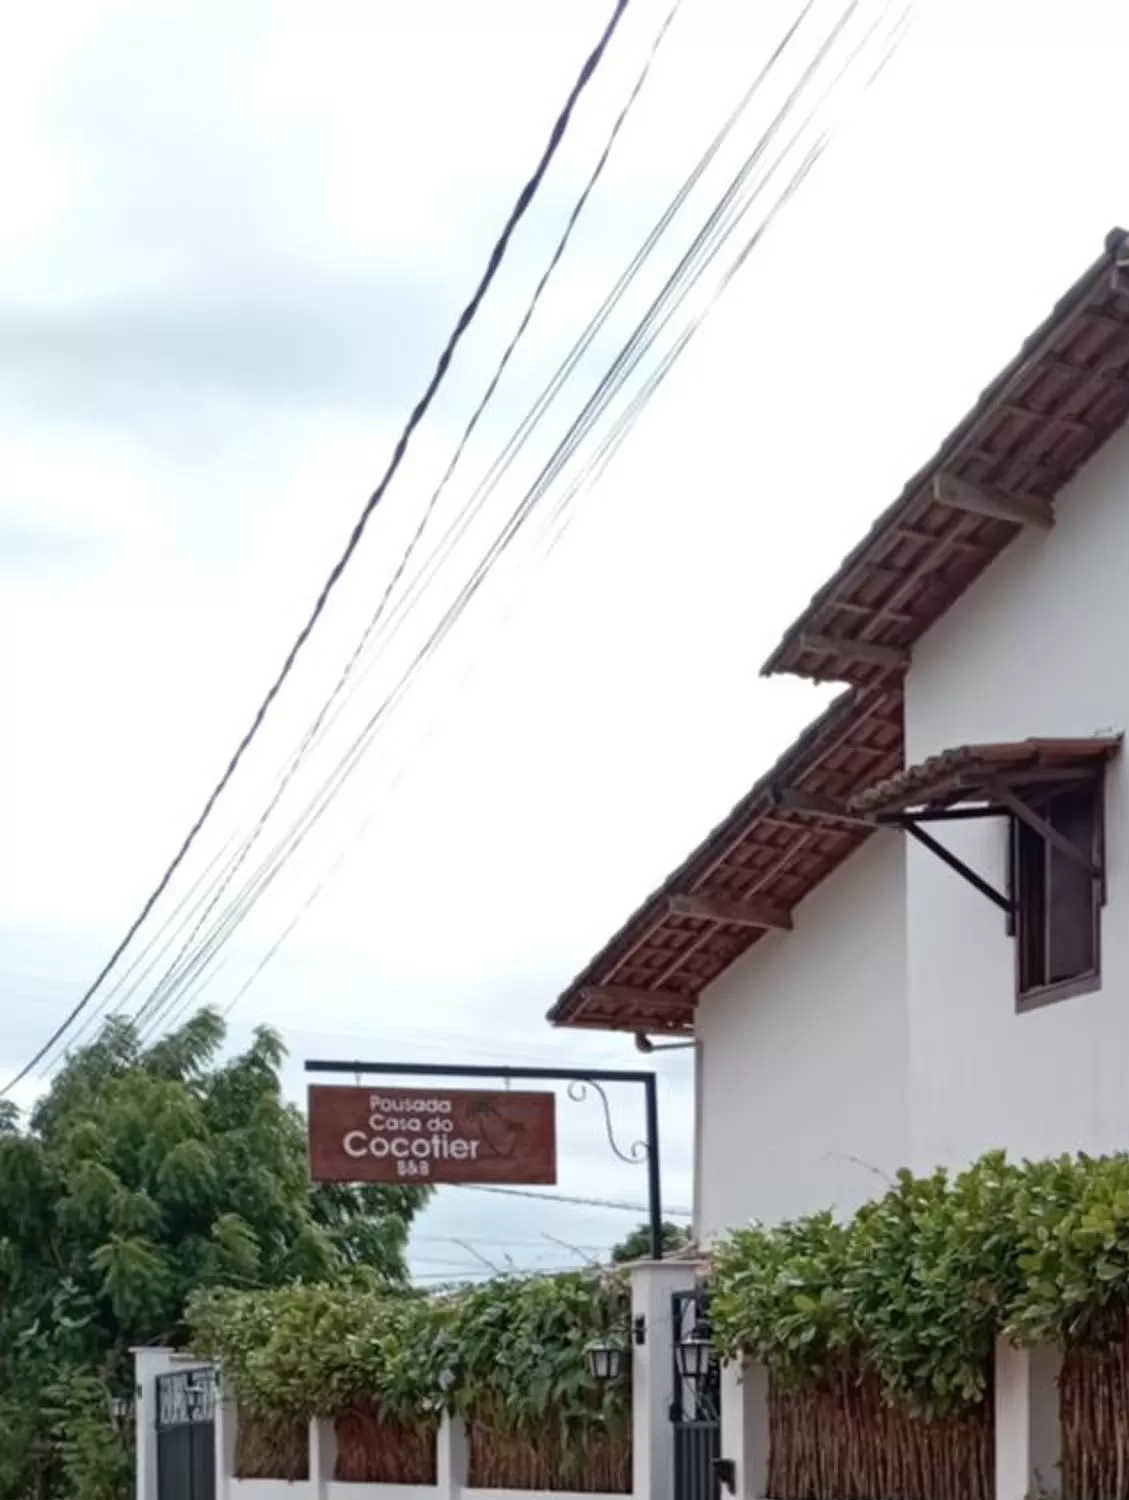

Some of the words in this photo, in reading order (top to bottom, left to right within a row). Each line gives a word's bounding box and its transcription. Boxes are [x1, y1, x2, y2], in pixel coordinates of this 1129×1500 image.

[369, 1095, 452, 1113] Pousada
[369, 1114, 421, 1132] Casa
[426, 1115, 454, 1132] do
[342, 1131, 480, 1159] Cocotier
[396, 1160, 430, 1177] B&B
